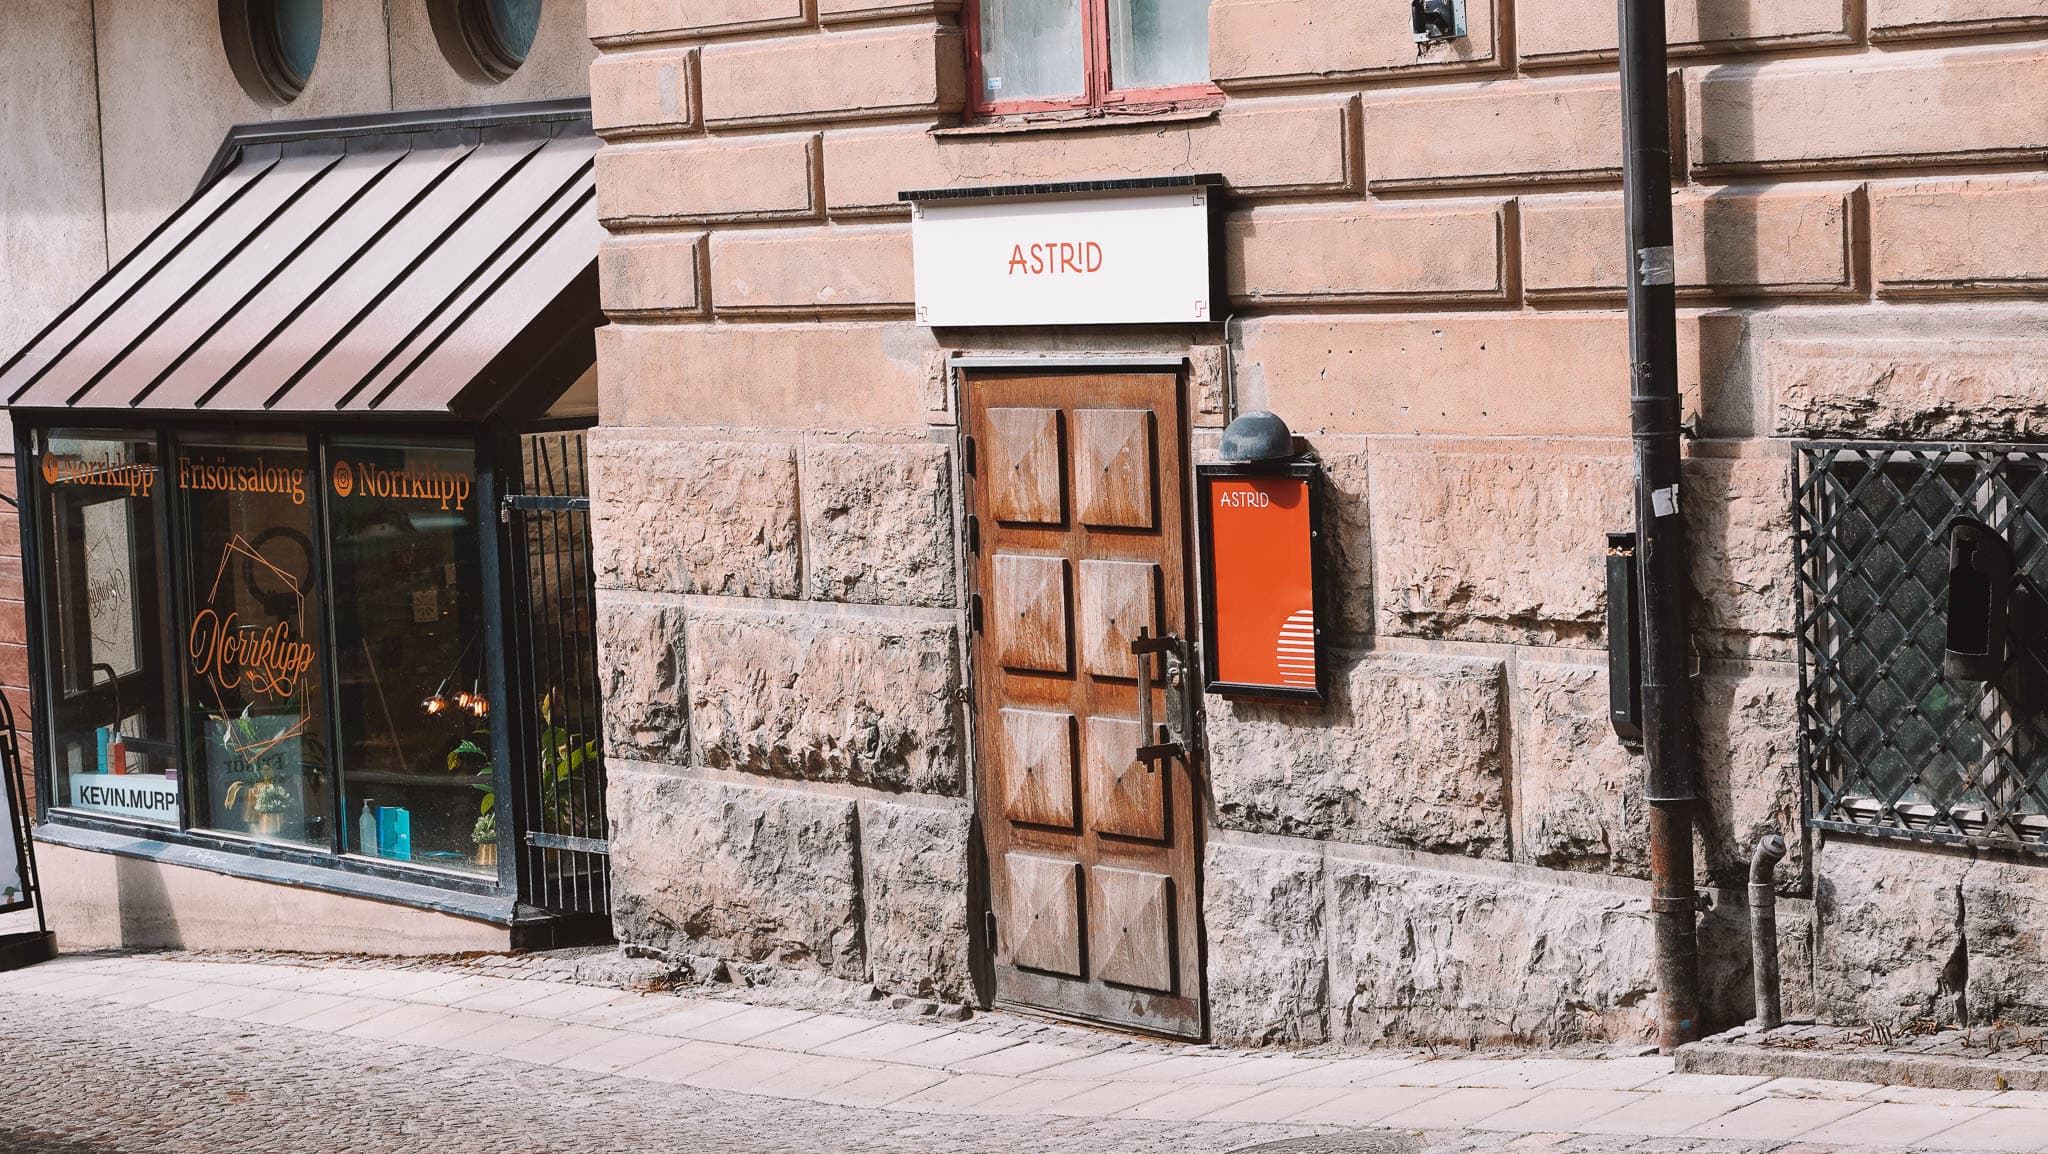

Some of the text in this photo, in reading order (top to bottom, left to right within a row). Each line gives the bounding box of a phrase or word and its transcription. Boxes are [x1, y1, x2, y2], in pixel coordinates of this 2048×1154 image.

[1008, 241, 1103, 274] ASTRID
[63, 451, 155, 497] Norrklipp
[178, 456, 305, 505] Frisörsalong
[358, 460, 471, 511] Norrklipp
[1220, 491, 1269, 508] ASTRID
[190, 609, 315, 698] Norrklipp
